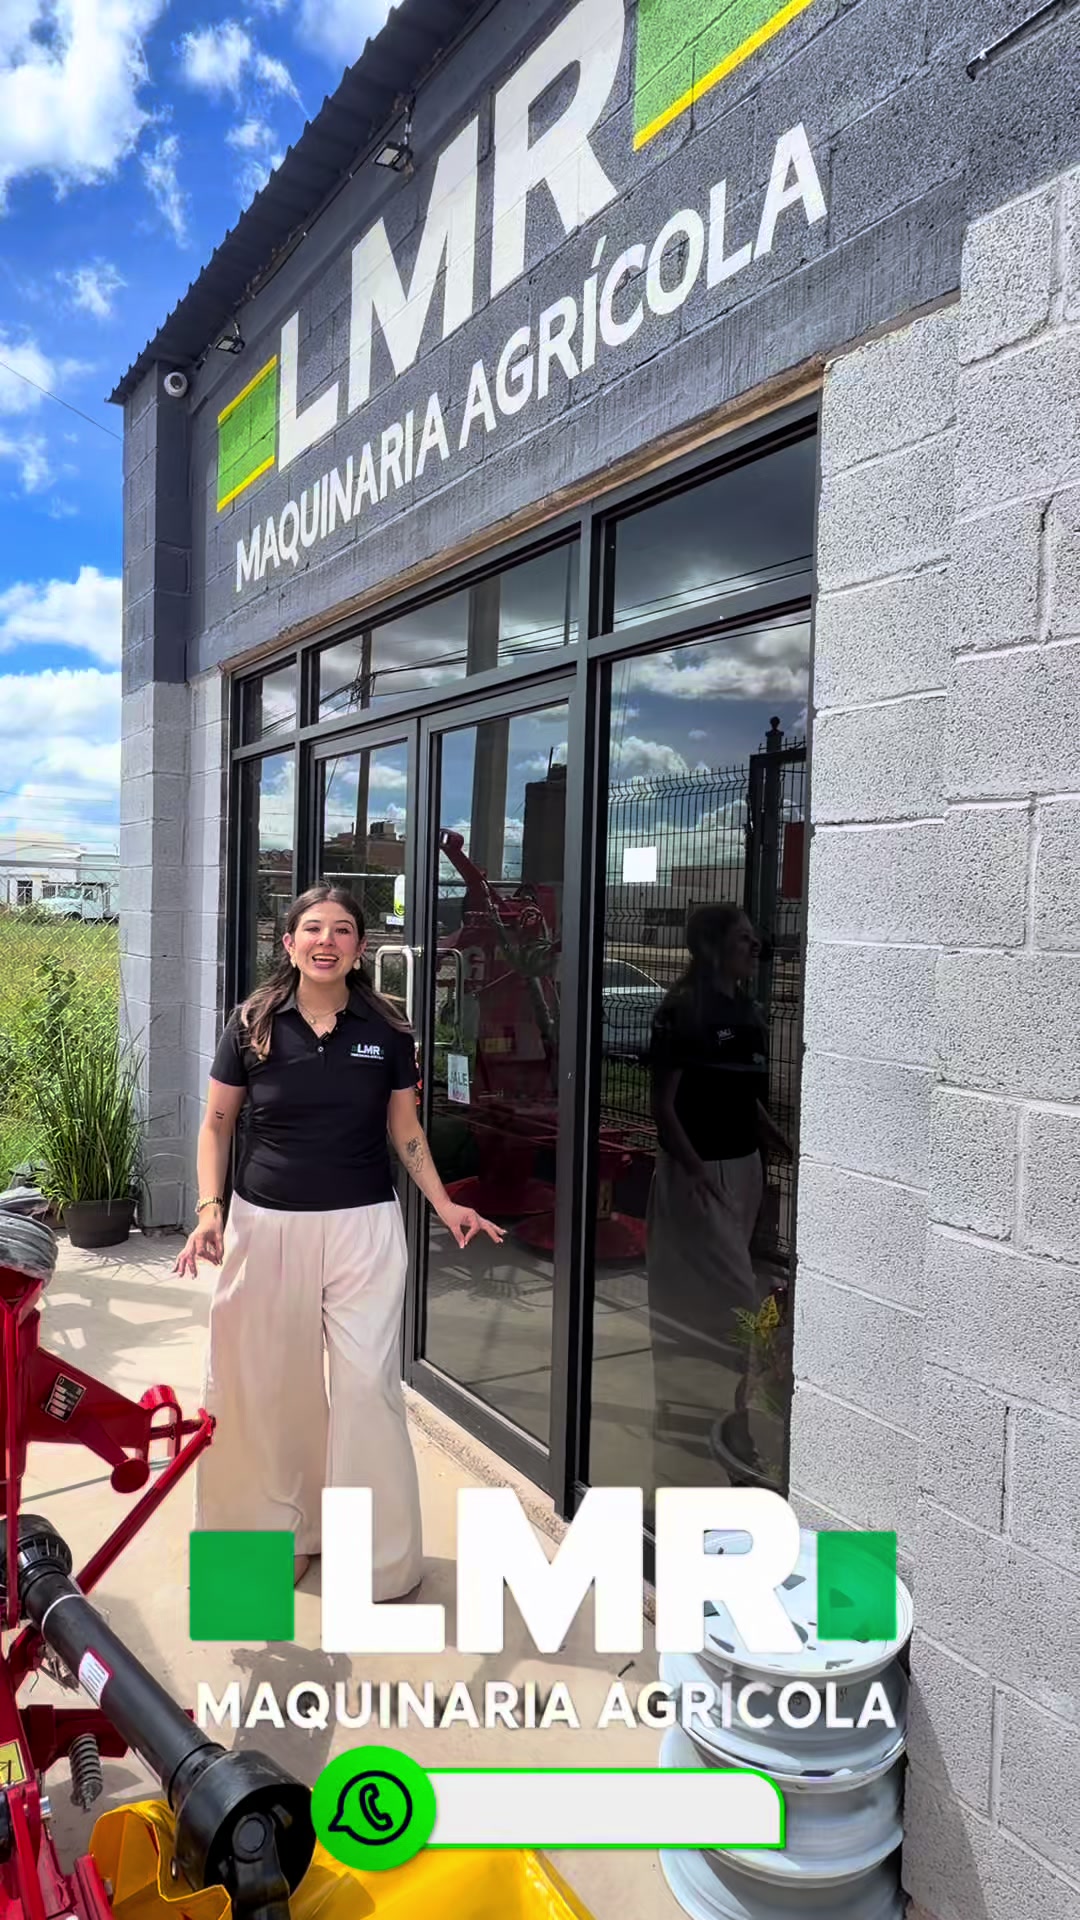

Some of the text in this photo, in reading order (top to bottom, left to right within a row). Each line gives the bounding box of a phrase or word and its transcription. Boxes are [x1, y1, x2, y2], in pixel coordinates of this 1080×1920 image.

[236, 122, 828, 592] MAQUINARIA AGRÍCOLA
[279, 0, 626, 472] LMR
[357, 1043, 381, 1055] LMR
